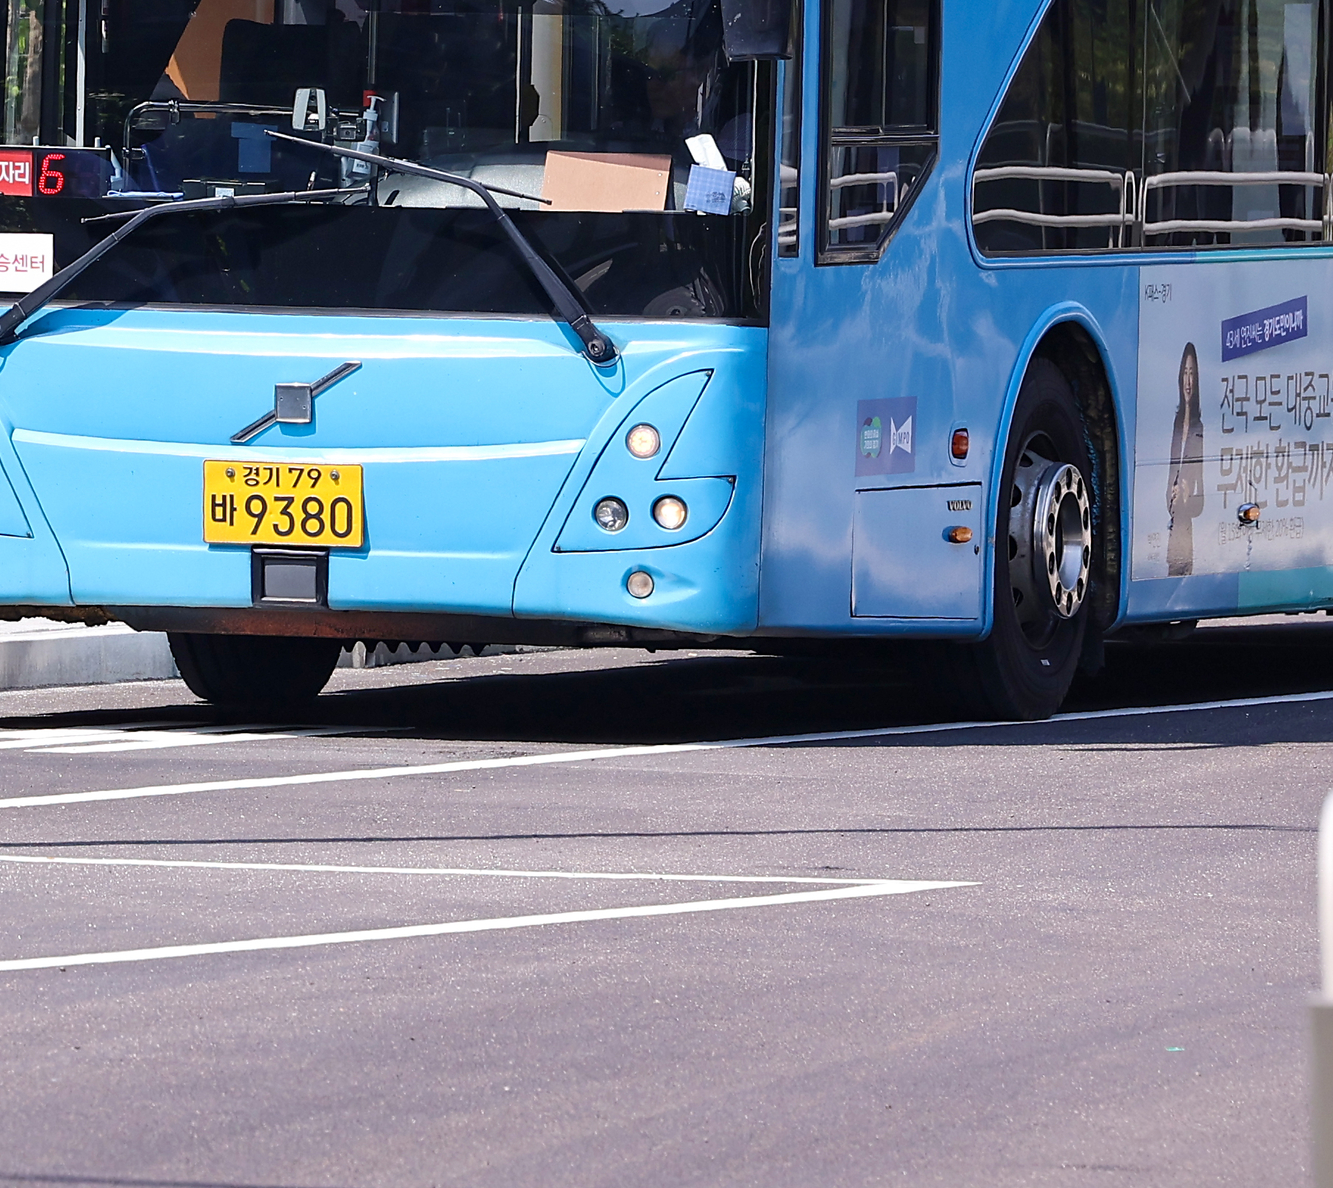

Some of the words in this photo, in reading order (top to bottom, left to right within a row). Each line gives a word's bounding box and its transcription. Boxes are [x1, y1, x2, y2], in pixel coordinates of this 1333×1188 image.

[39, 153, 66, 195] 6
[1264, 309, 1304, 342] 경기도민이니까
[1220, 375, 1250, 433] 전국
[1253, 374, 1283, 431] 모든
[1286, 371, 1333, 431] 대중교
[243, 466, 280, 488] 경기
[288, 467, 322, 489] 79
[1217, 440, 1271, 510] 무제한
[211, 494, 238, 527] 바
[244, 494, 353, 538] 9380
[946, 499, 972, 512] VOLVO
